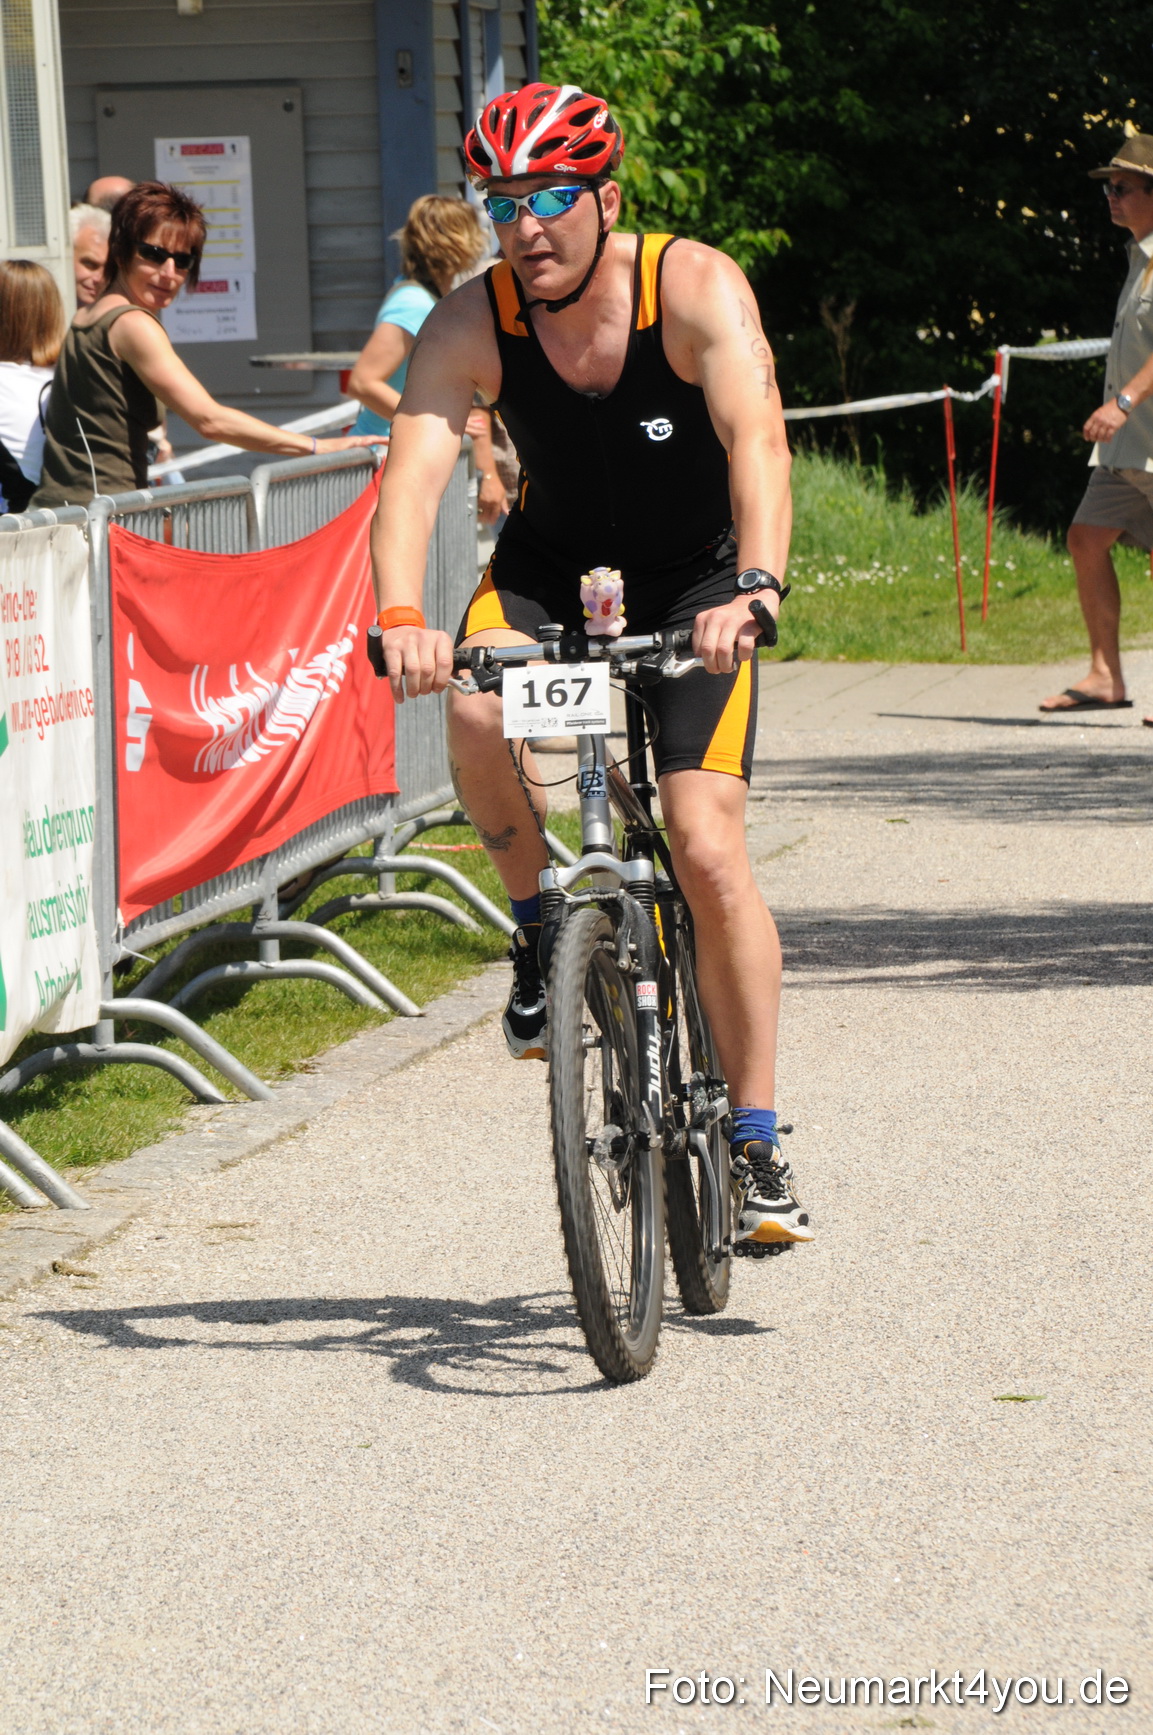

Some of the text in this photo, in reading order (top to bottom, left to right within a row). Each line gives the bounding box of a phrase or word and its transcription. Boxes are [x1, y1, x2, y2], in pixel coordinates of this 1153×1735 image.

[554, 163, 578, 173] Giro
[522, 677, 592, 708] 167
[637, 984, 656, 995] ROCK
